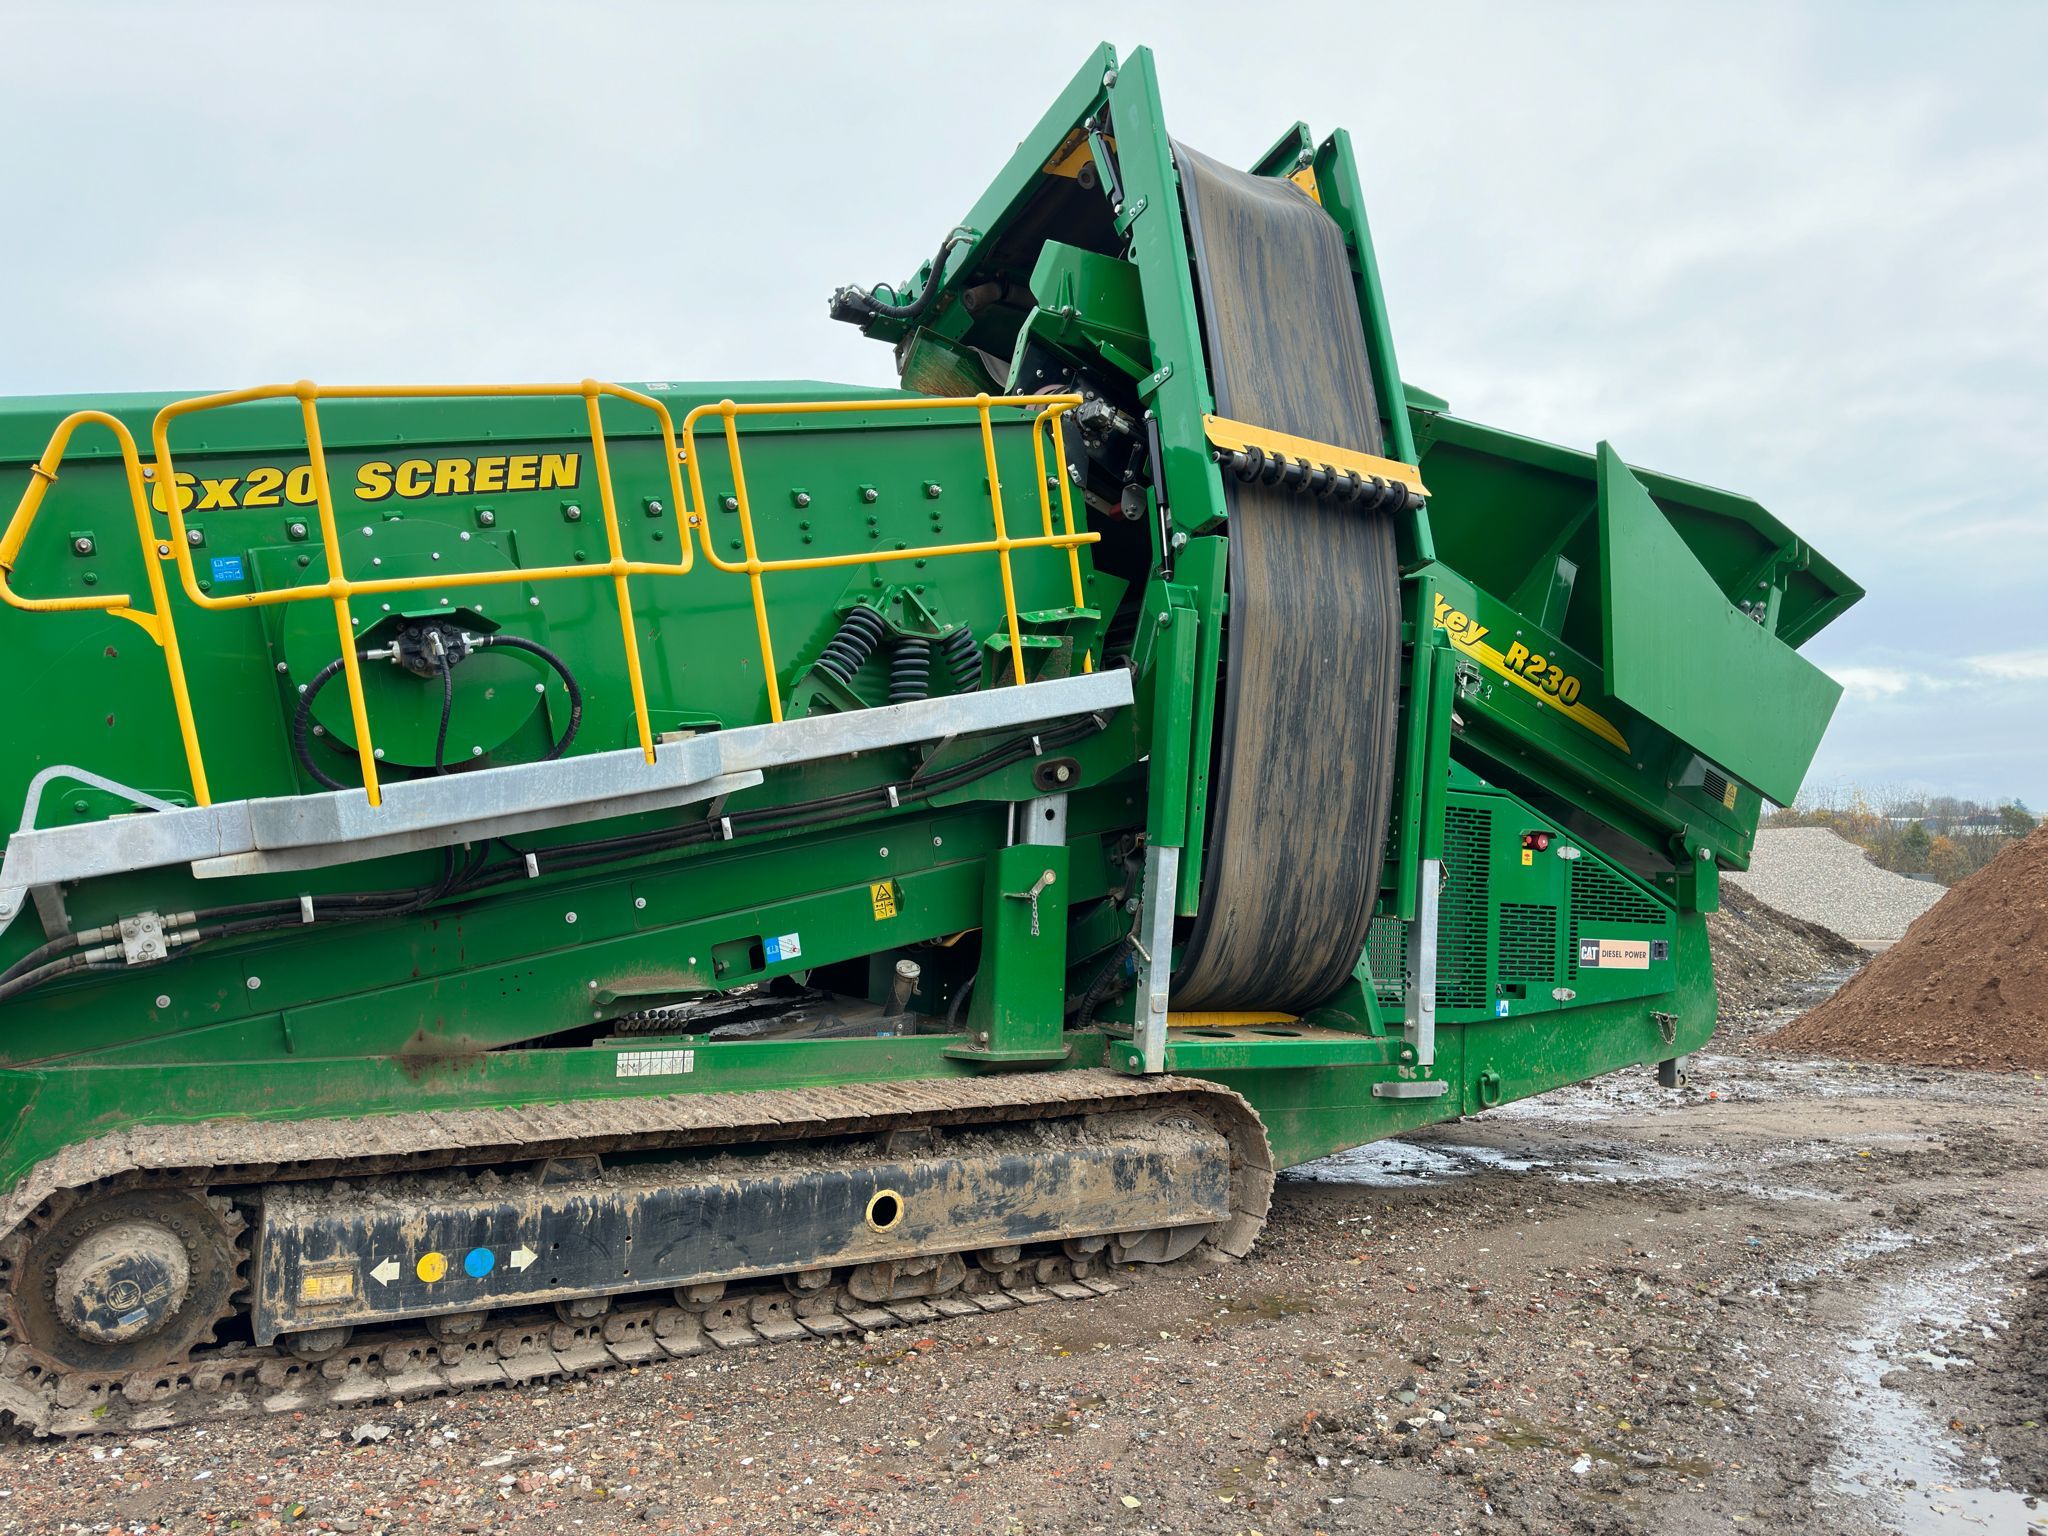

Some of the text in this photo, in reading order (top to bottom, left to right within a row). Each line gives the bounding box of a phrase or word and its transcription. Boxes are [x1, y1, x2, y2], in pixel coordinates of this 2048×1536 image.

[151, 453, 582, 515] 6x20 SCREEN
[1503, 640, 1582, 706] R230
[1581, 946, 1647, 960] CAT DIESEL POWER
